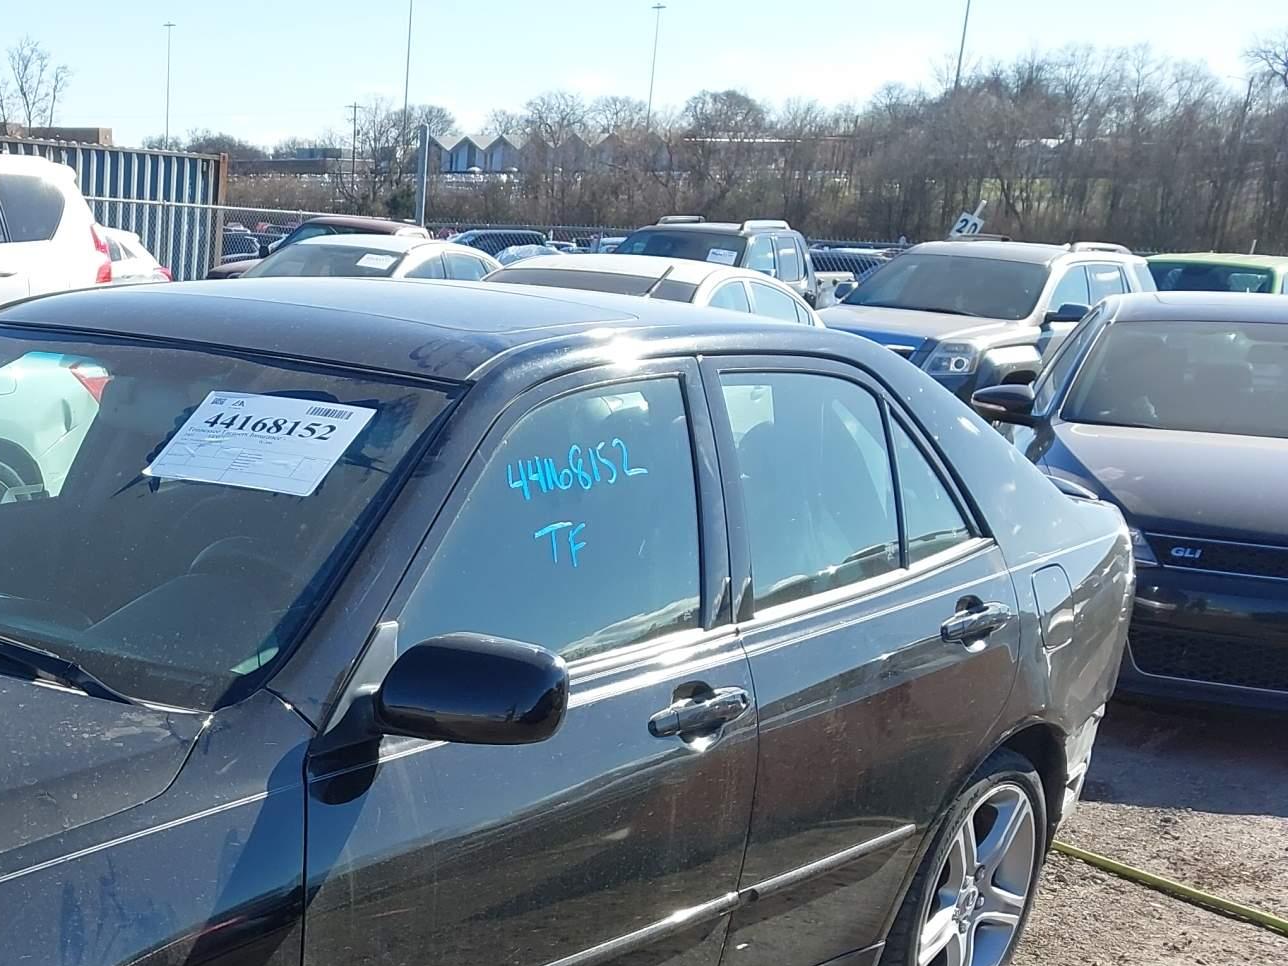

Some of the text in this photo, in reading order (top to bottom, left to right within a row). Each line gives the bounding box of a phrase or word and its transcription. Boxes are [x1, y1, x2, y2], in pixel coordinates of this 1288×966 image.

[204, 412, 337, 441] 44168152
[507, 438, 649, 501] 44168152
[533, 521, 587, 568] TF
[1171, 546, 1202, 559] GLI
